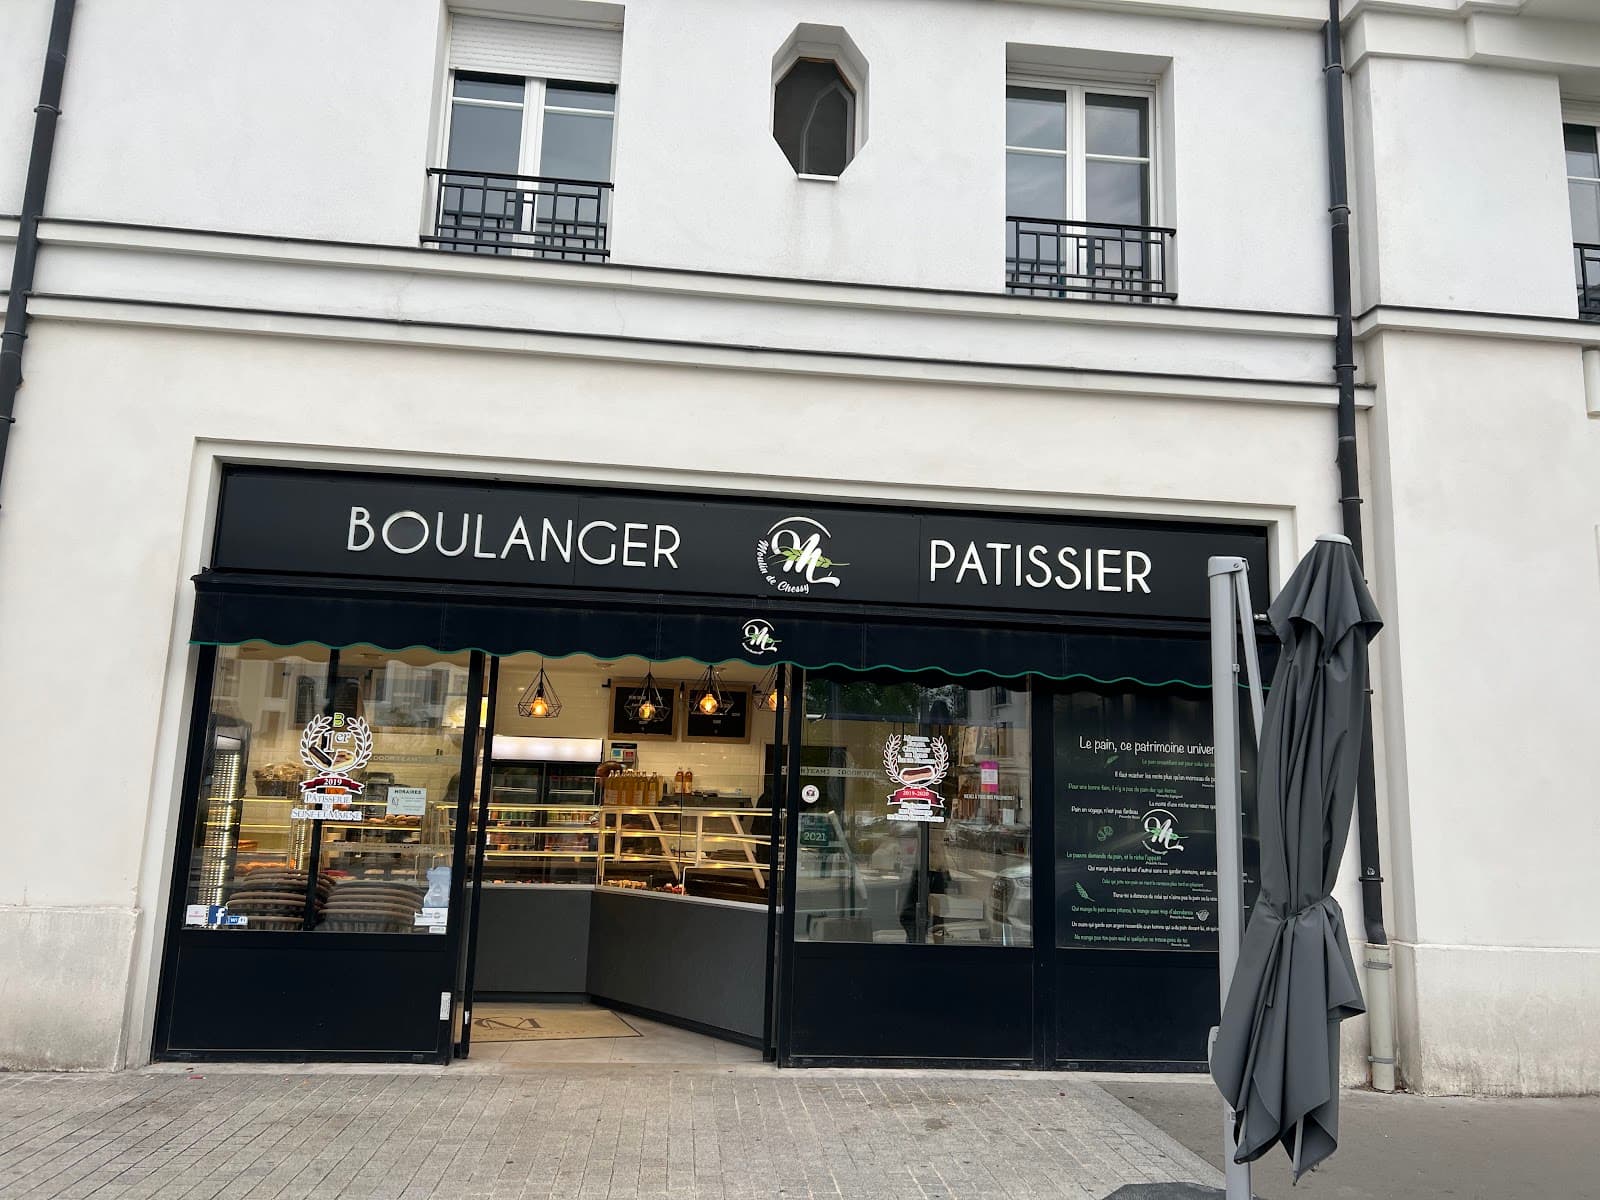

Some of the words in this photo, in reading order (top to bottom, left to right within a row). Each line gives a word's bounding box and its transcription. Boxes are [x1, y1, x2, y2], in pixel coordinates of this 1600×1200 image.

[347, 506, 681, 569] BOULANGER
[756, 540, 769, 574] Moulin
[766, 574, 777, 585] de
[777, 581, 810, 594] Chessy
[929, 539, 1151, 594] PATISSIER
[1080, 735, 1092, 749] Le
[1094, 739, 1118, 754] pain,
[1120, 742, 1133, 751] ce
[1134, 740, 1185, 756] patrimoine
[1187, 743, 1215, 756] univer
[804, 832, 827, 842] 2021
